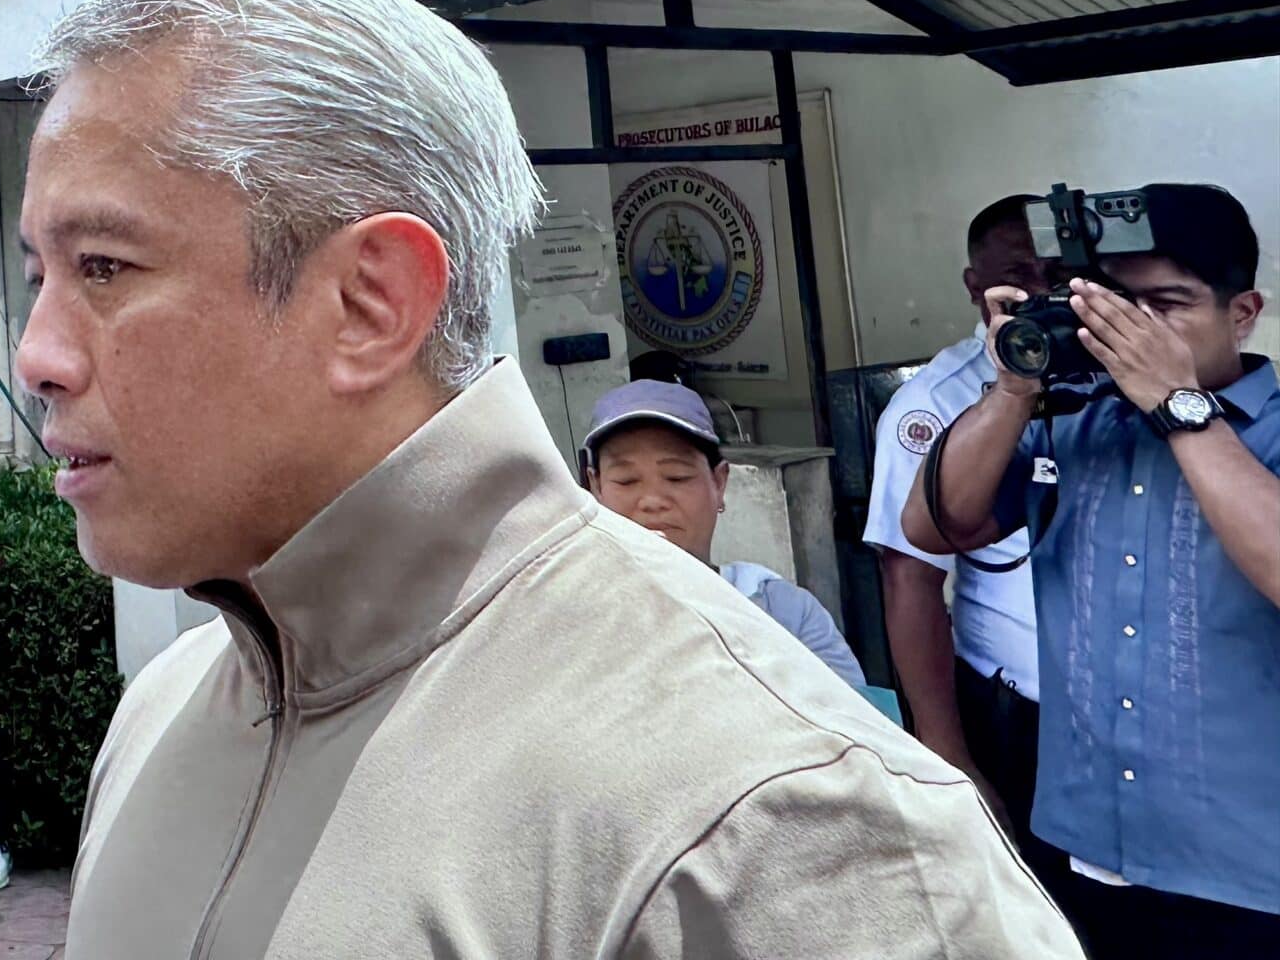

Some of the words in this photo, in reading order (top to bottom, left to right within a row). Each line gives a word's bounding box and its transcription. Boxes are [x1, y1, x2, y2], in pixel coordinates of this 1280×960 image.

[617, 122, 712, 147] PROSECUTORS
[715, 119, 731, 136] OF
[736, 114, 782, 134] BULAC
[683, 180, 705, 197] OF
[705, 192, 747, 262] JUSTICE
